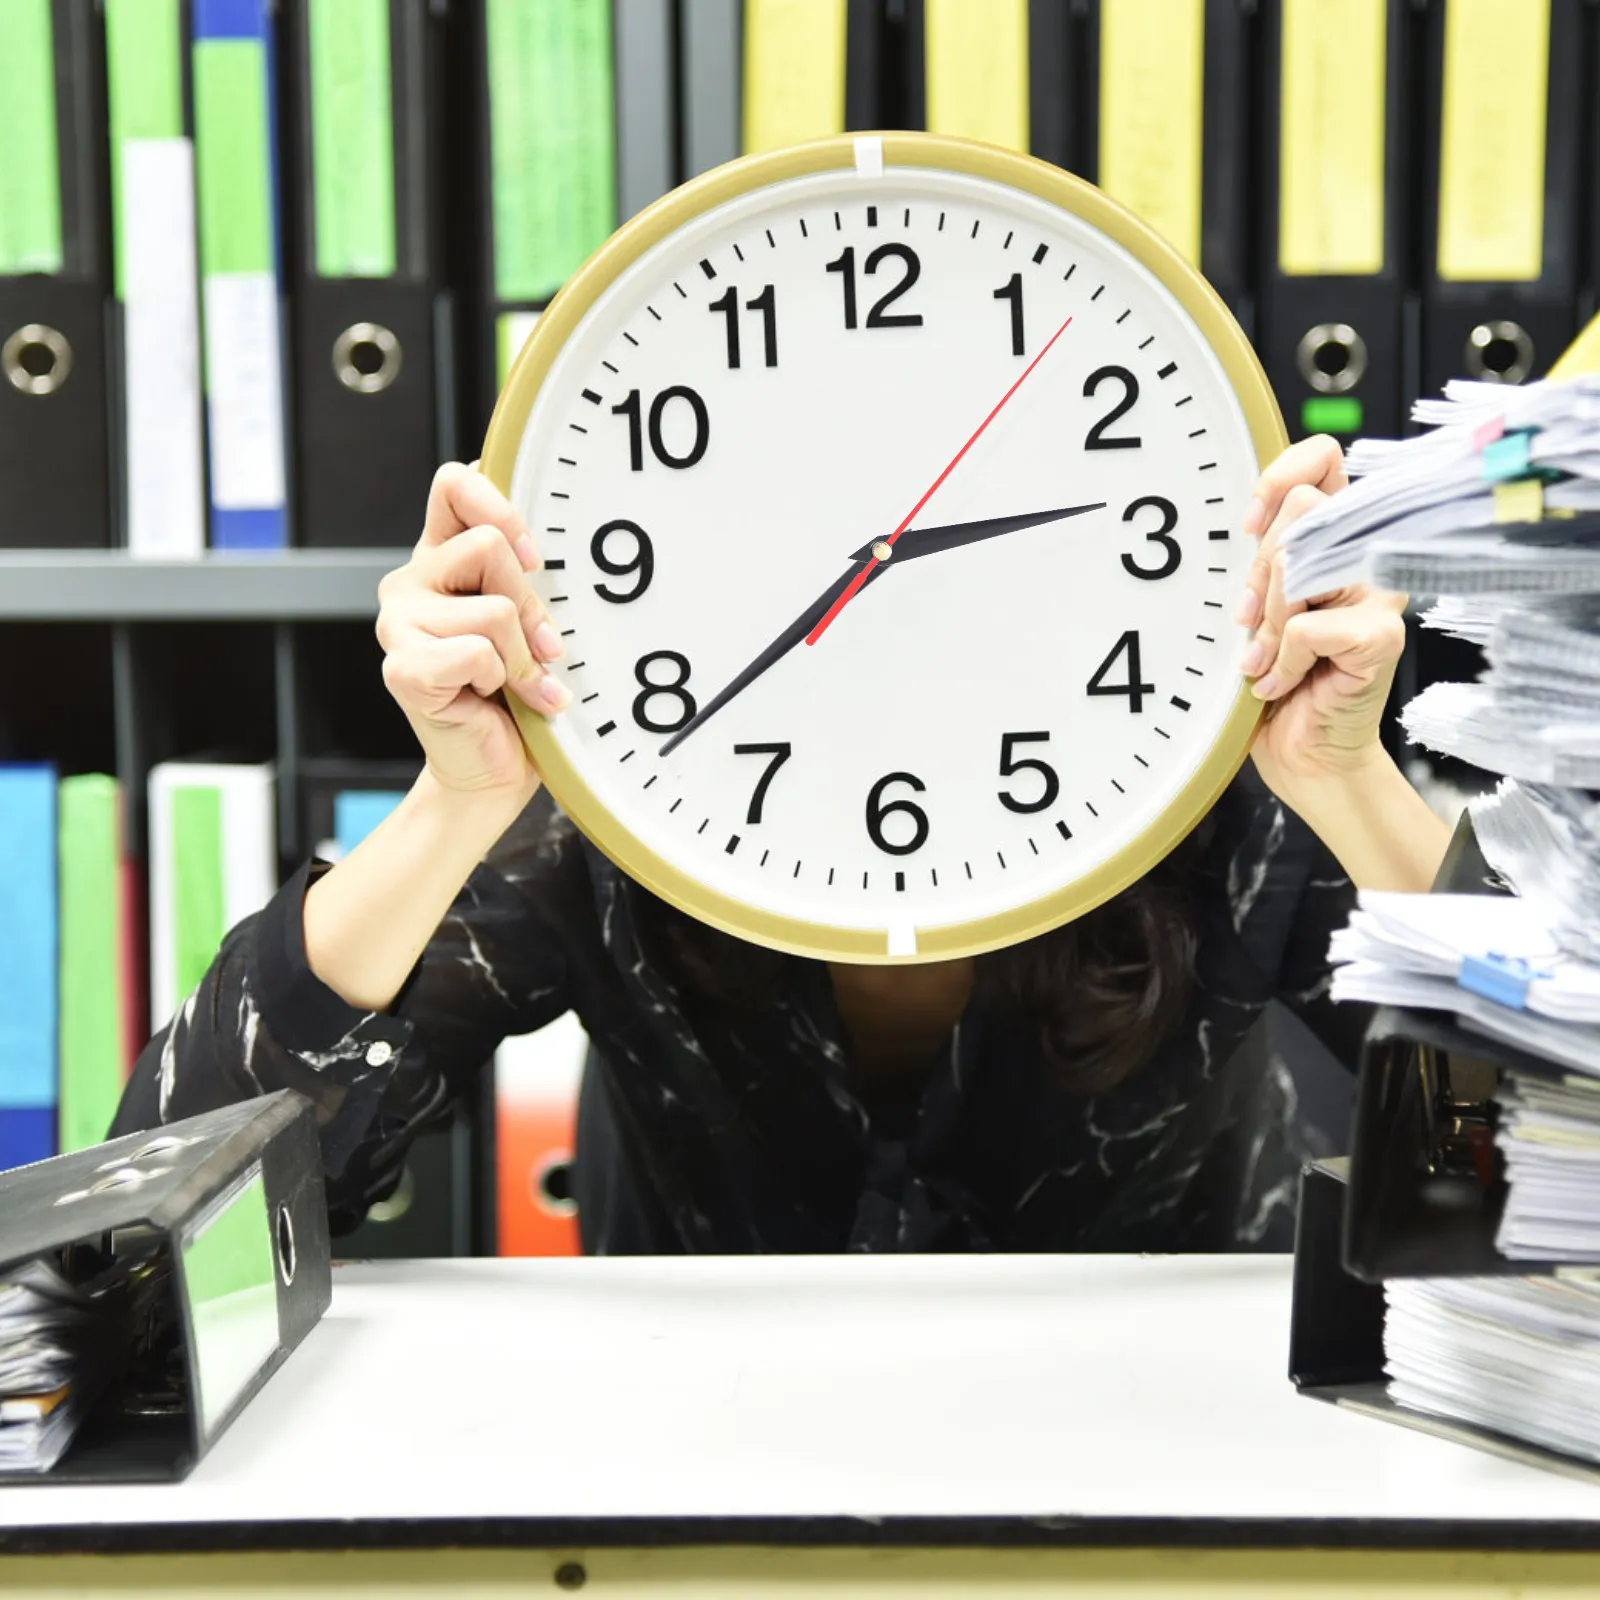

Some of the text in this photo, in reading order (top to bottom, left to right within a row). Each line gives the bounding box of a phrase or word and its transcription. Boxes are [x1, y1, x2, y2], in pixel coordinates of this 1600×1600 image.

[709, 285, 777, 368] 11
[826, 243, 923, 328] 12
[994, 274, 1024, 355] 1
[612, 386, 709, 471] 10
[1083, 366, 1141, 450] 2
[591, 520, 654, 603] 9
[1122, 497, 1181, 580] 3
[632, 650, 697, 734] 8
[1087, 631, 1154, 713] 4
[734, 743, 791, 824] 7
[866, 772, 929, 855] 6
[999, 731, 1059, 814] 5
